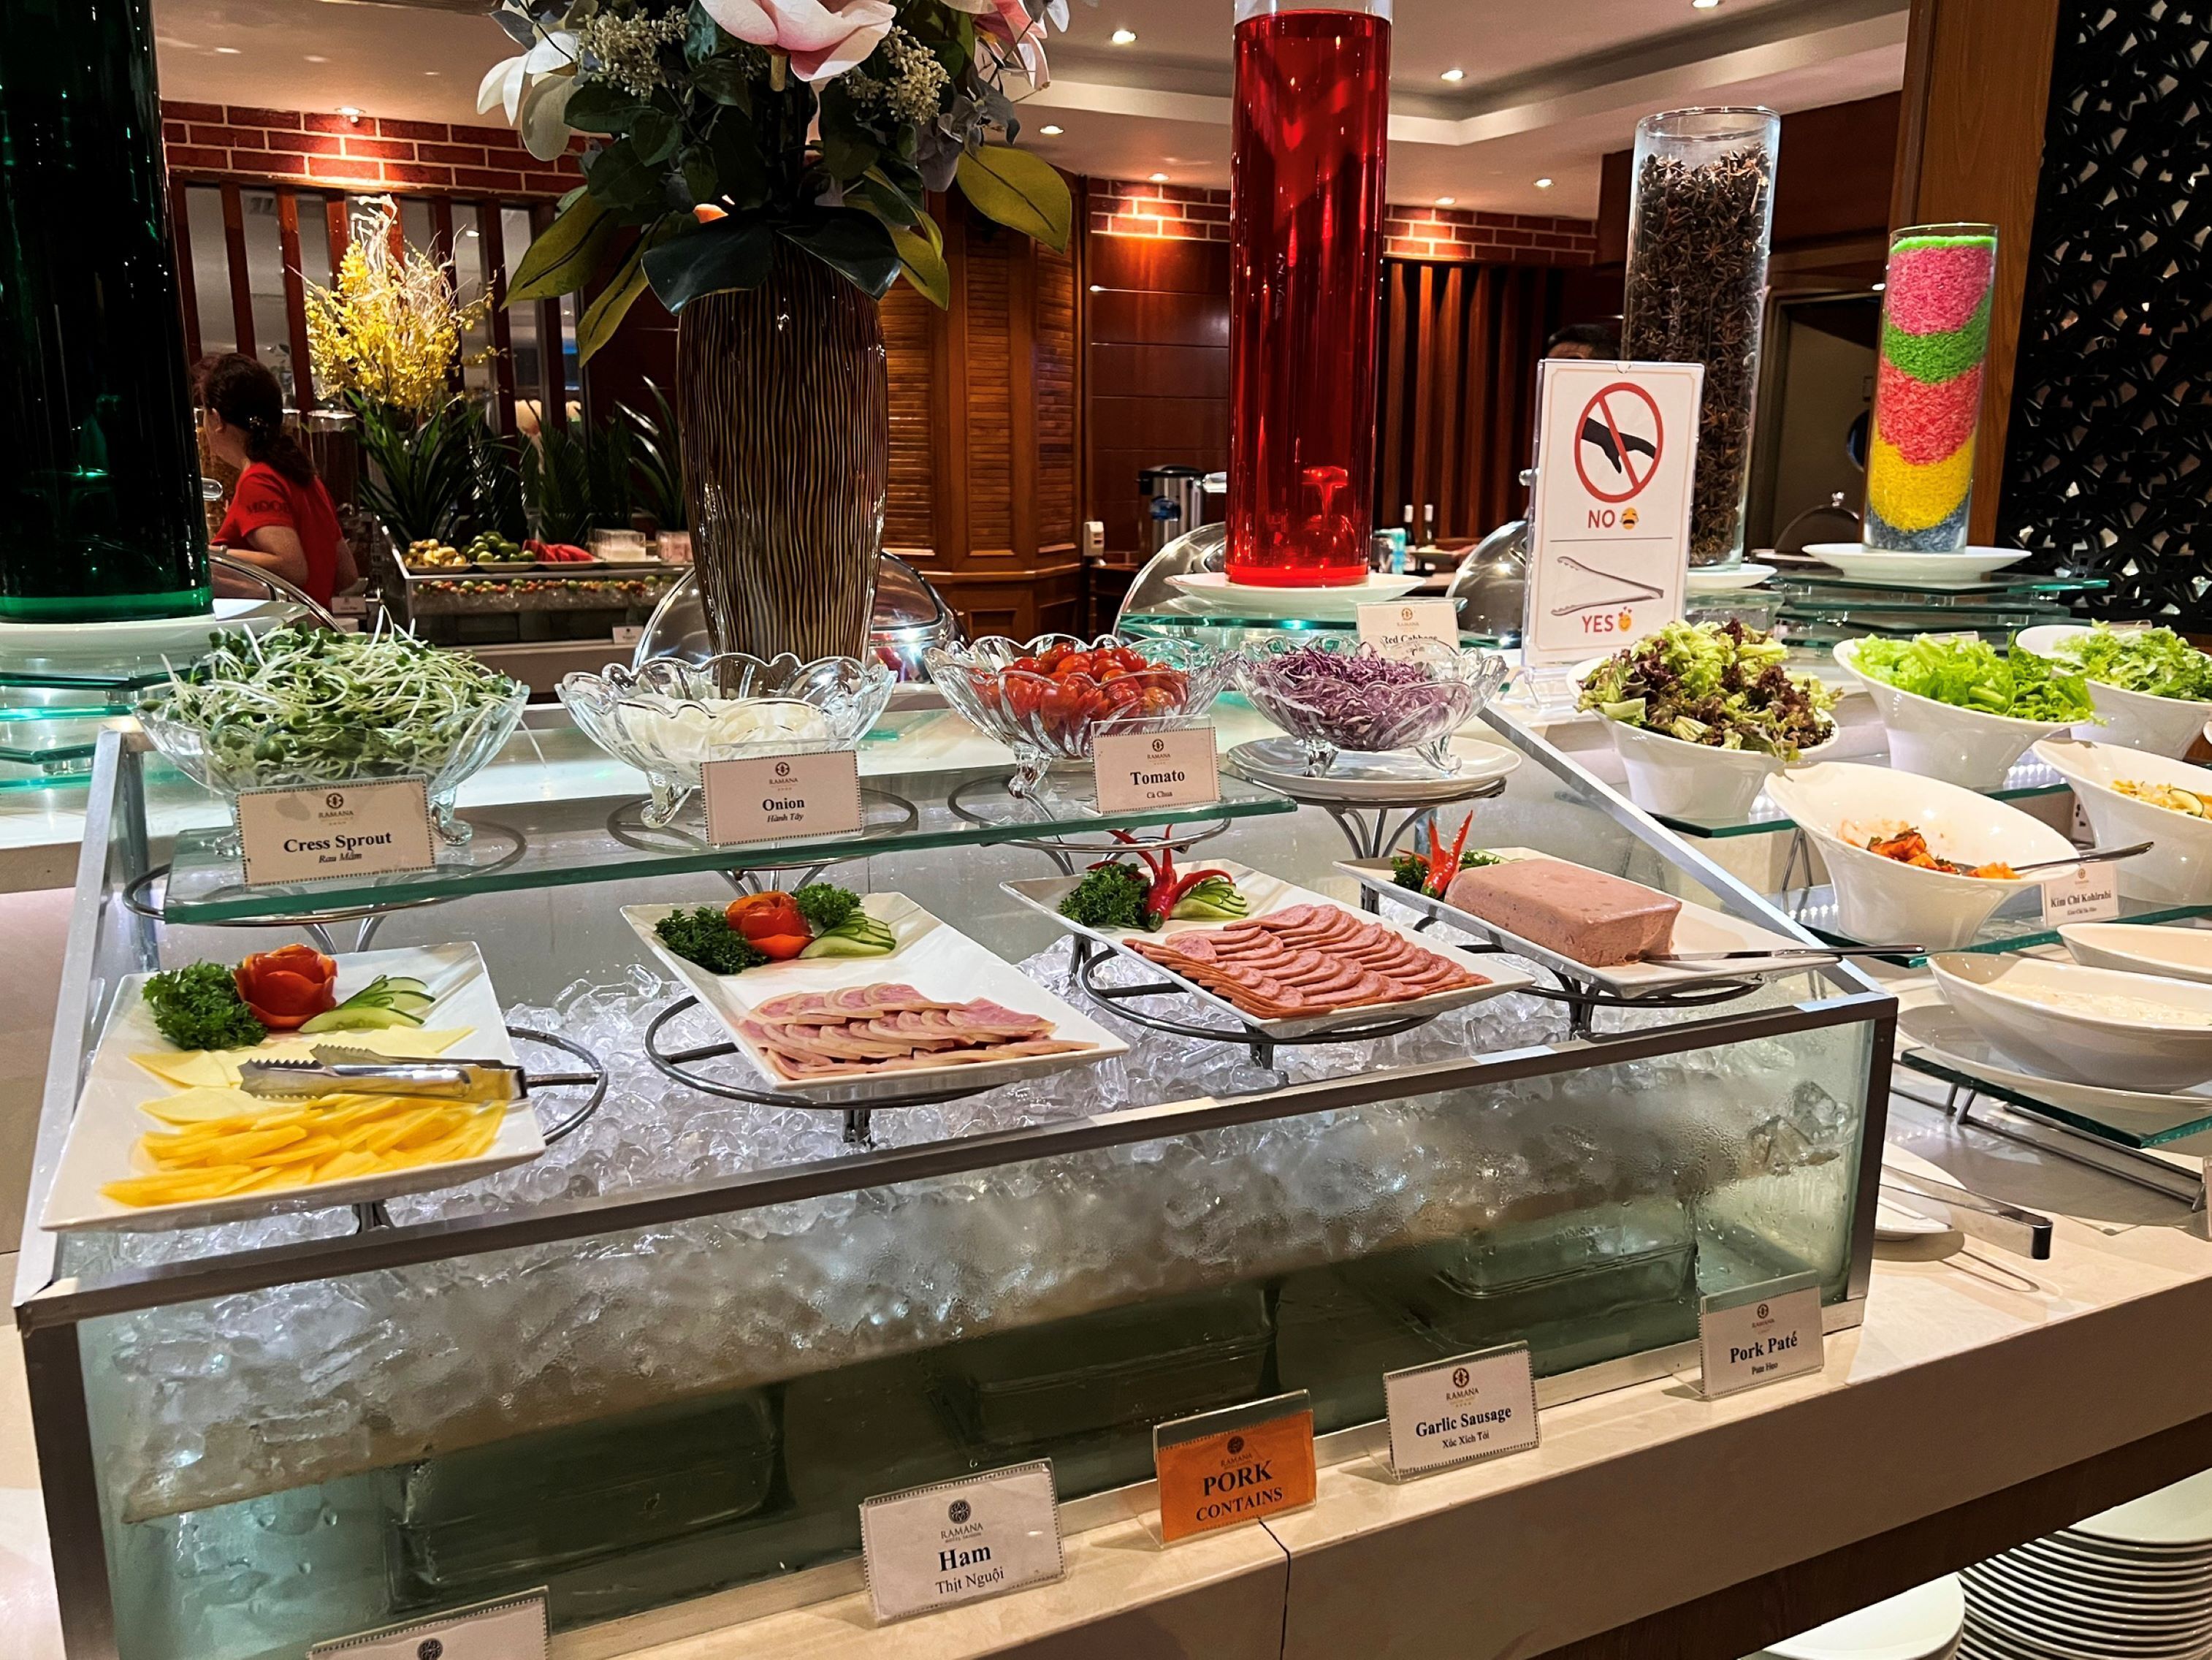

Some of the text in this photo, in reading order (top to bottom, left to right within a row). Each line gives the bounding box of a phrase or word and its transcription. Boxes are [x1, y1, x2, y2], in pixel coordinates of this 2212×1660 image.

[1587, 510, 1615, 529] NO
[1582, 616, 1613, 633] YES
[1130, 770, 1185, 785] Tomato
[762, 798, 805, 811] Onion
[319, 810, 354, 818] RAMANA
[283, 832, 392, 853] Cress Sprout
[319, 855, 337, 863] Rau
[2051, 896, 2066, 907] Kim
[2067, 894, 2080, 905] Chi
[1730, 1330, 1798, 1363] Pork Paté
[1446, 1387, 1479, 1401] RAMANA
[1416, 1408, 1511, 1436] Garlic Sausage
[1221, 1453, 1253, 1466] RAMANA
[1203, 1460, 1273, 1496] PORK
[1196, 1488, 1283, 1521] CONTAINS
[940, 1523, 983, 1539] RAMANA
[938, 1547, 991, 1572] Ham
[935, 1567, 1004, 1594] Thịt Nguội
